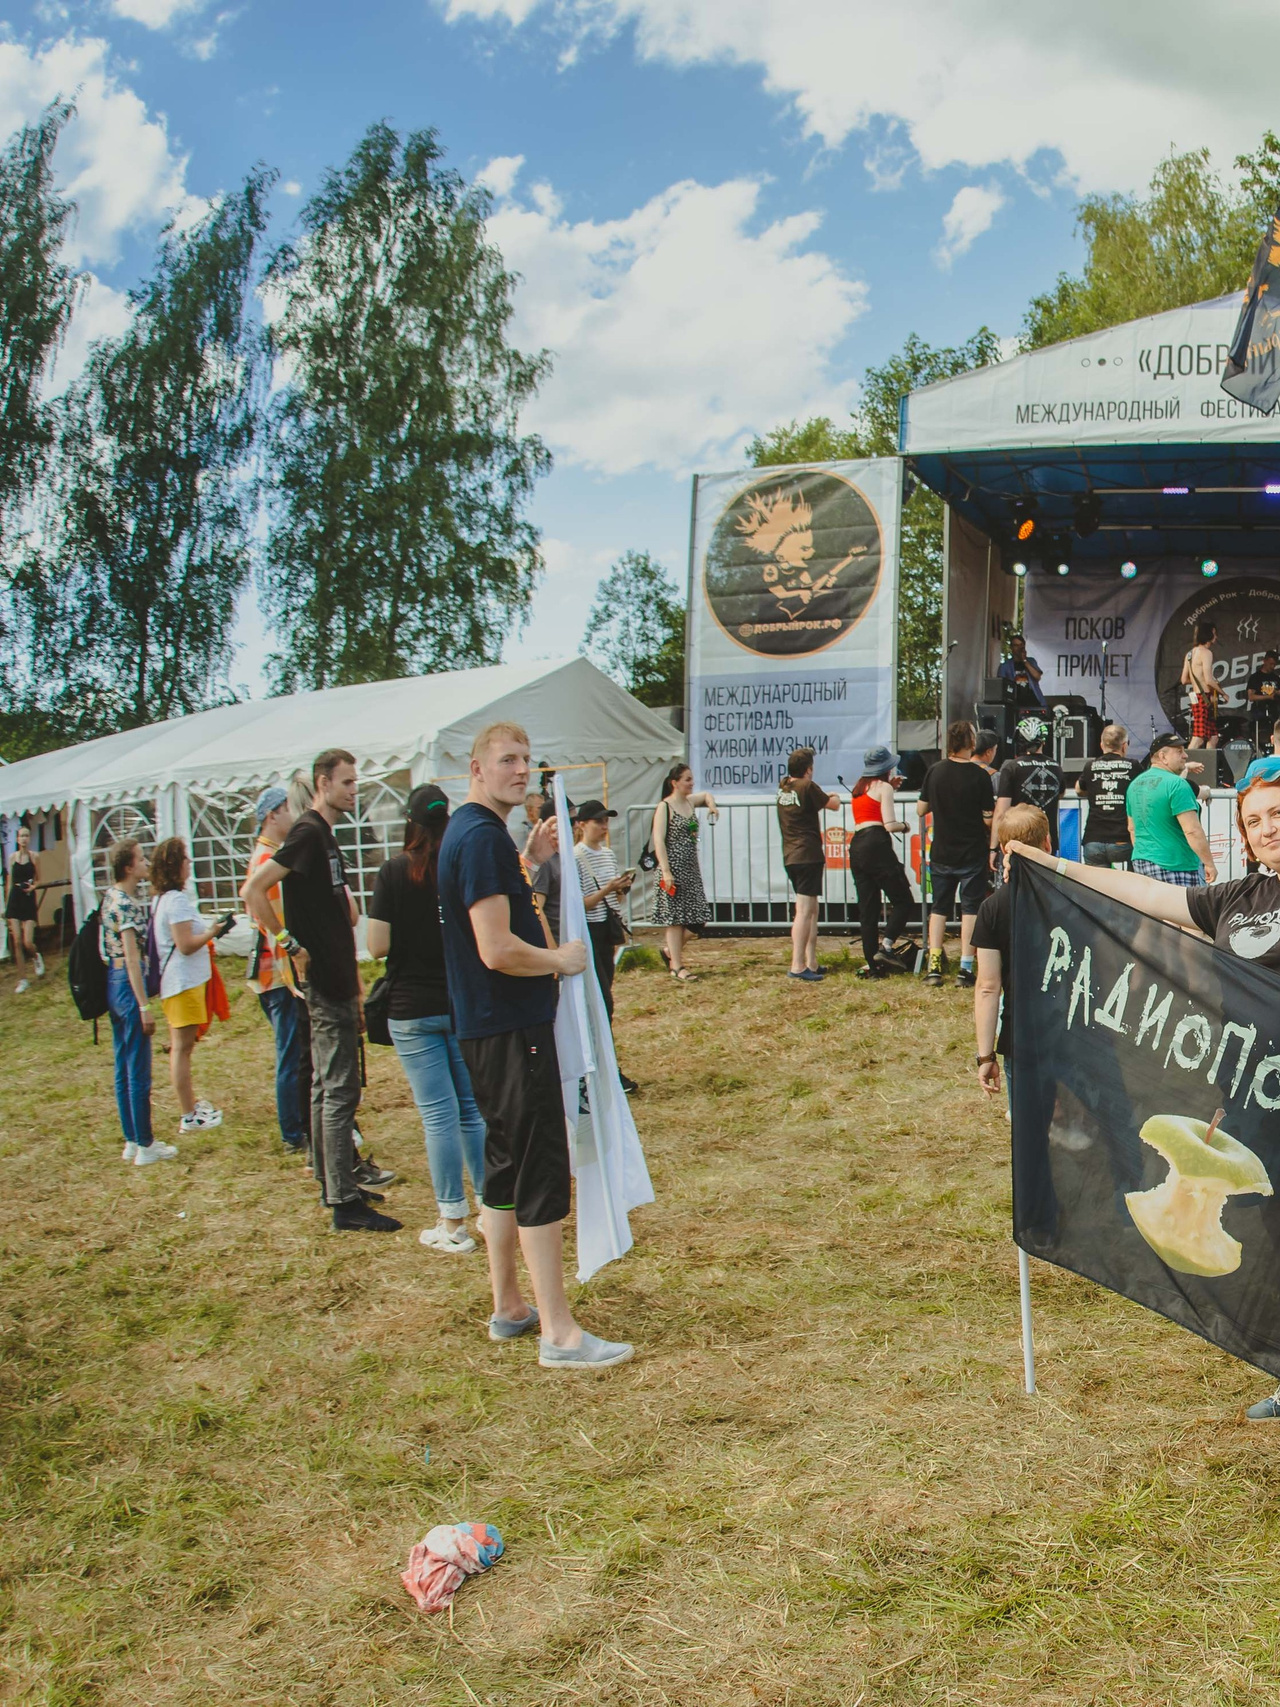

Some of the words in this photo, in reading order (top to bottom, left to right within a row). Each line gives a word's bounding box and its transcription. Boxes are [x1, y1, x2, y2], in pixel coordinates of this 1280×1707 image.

[1016, 396, 1181, 425] МЕЖДУНАРОДНЫЙ
[1219, 592, 1238, 601] Рок
[753, 618, 843, 635] ДОБРЫЙРОК.РФ
[1064, 616, 1126, 640] ПСКОВ
[1057, 653, 1133, 678] ПРИМЕТ
[704, 677, 847, 707] МЕЖДУНАРОДНЫЙ
[704, 709, 794, 732] ФЕСТИВАЛЬ
[704, 734, 758, 759] ЖИВОЙ
[704, 761, 774, 787] «ДОБРЫЙ
